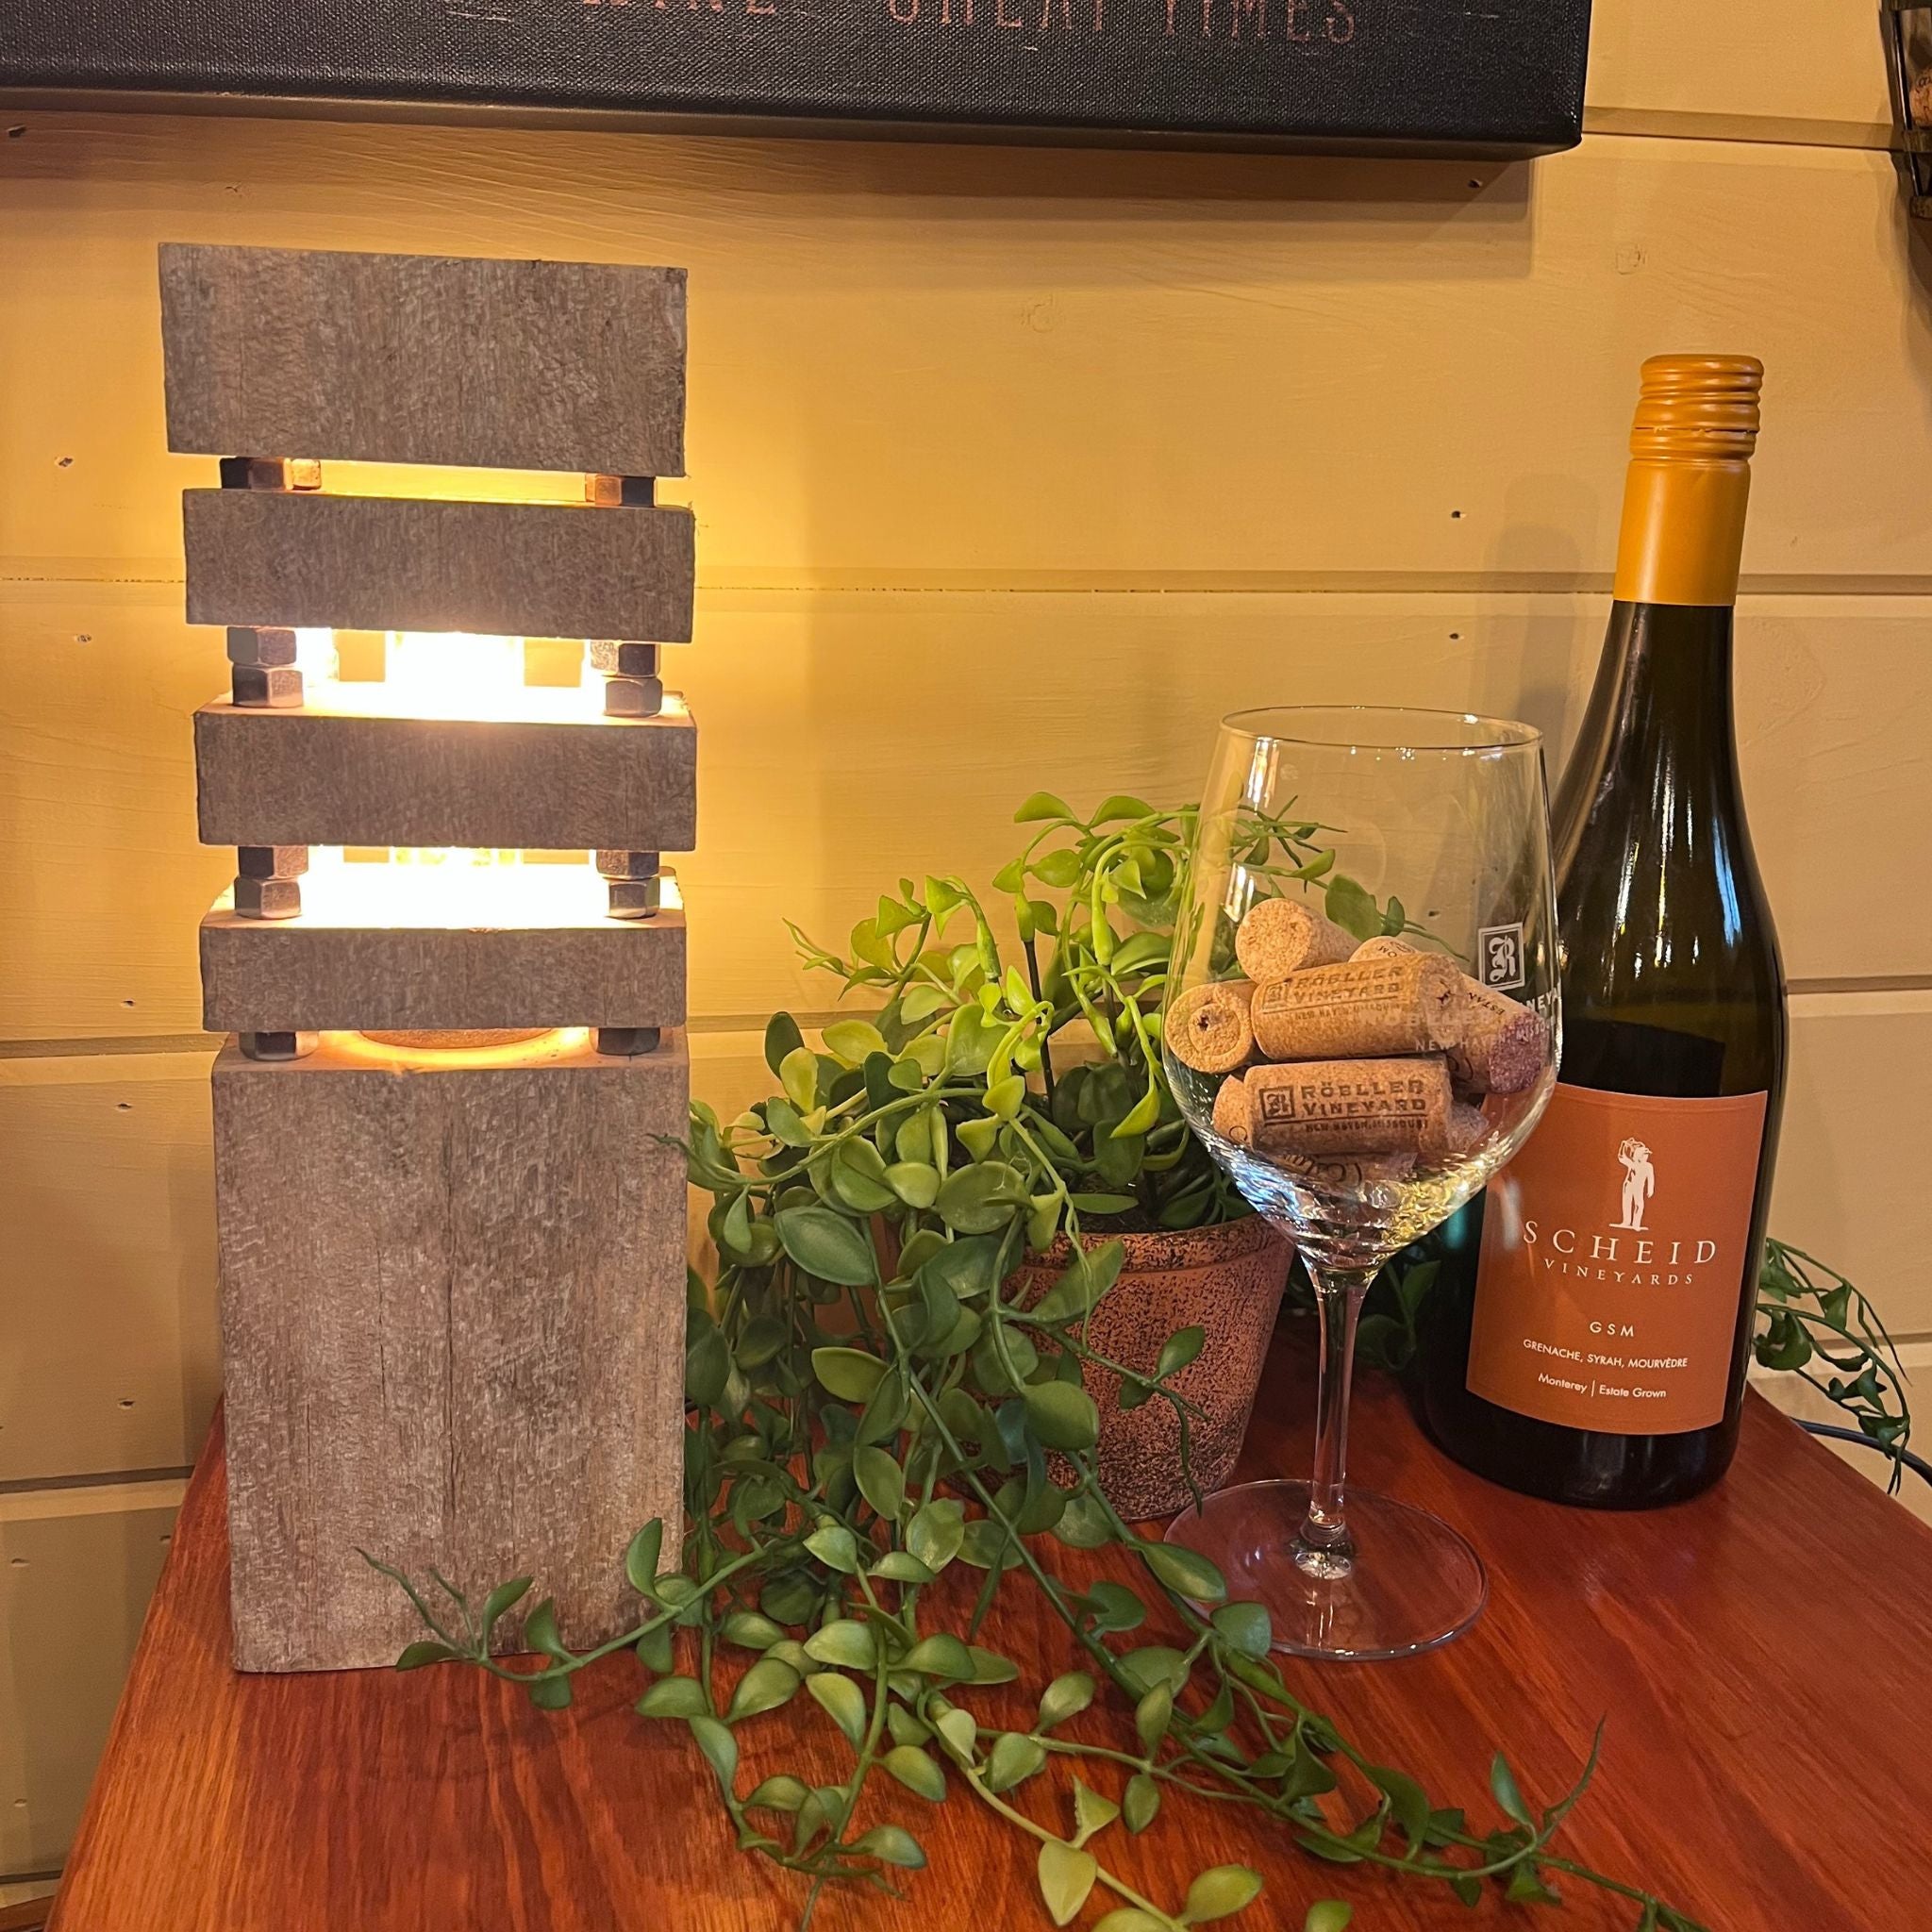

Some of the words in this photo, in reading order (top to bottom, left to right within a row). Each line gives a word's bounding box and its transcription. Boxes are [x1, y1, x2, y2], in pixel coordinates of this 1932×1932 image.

[1293, 982, 1402, 1005] VINEYARD
[1416, 1040, 1453, 1052] NEW
[1303, 1098, 1426, 1117] VINEYARD
[1524, 1220, 1717, 1265] SCHEID
[1544, 1257, 1693, 1286] VINEYARDS
[1523, 1339, 1584, 1363] GRENACHE,
[1587, 1353, 1625, 1369] SYRAH,
[1627, 1357, 1689, 1369] MOURVÈDRE
[1538, 1373, 1588, 1393] Monterey
[1599, 1384, 1630, 1397] Estate
[1633, 1388, 1667, 1398] Grown
